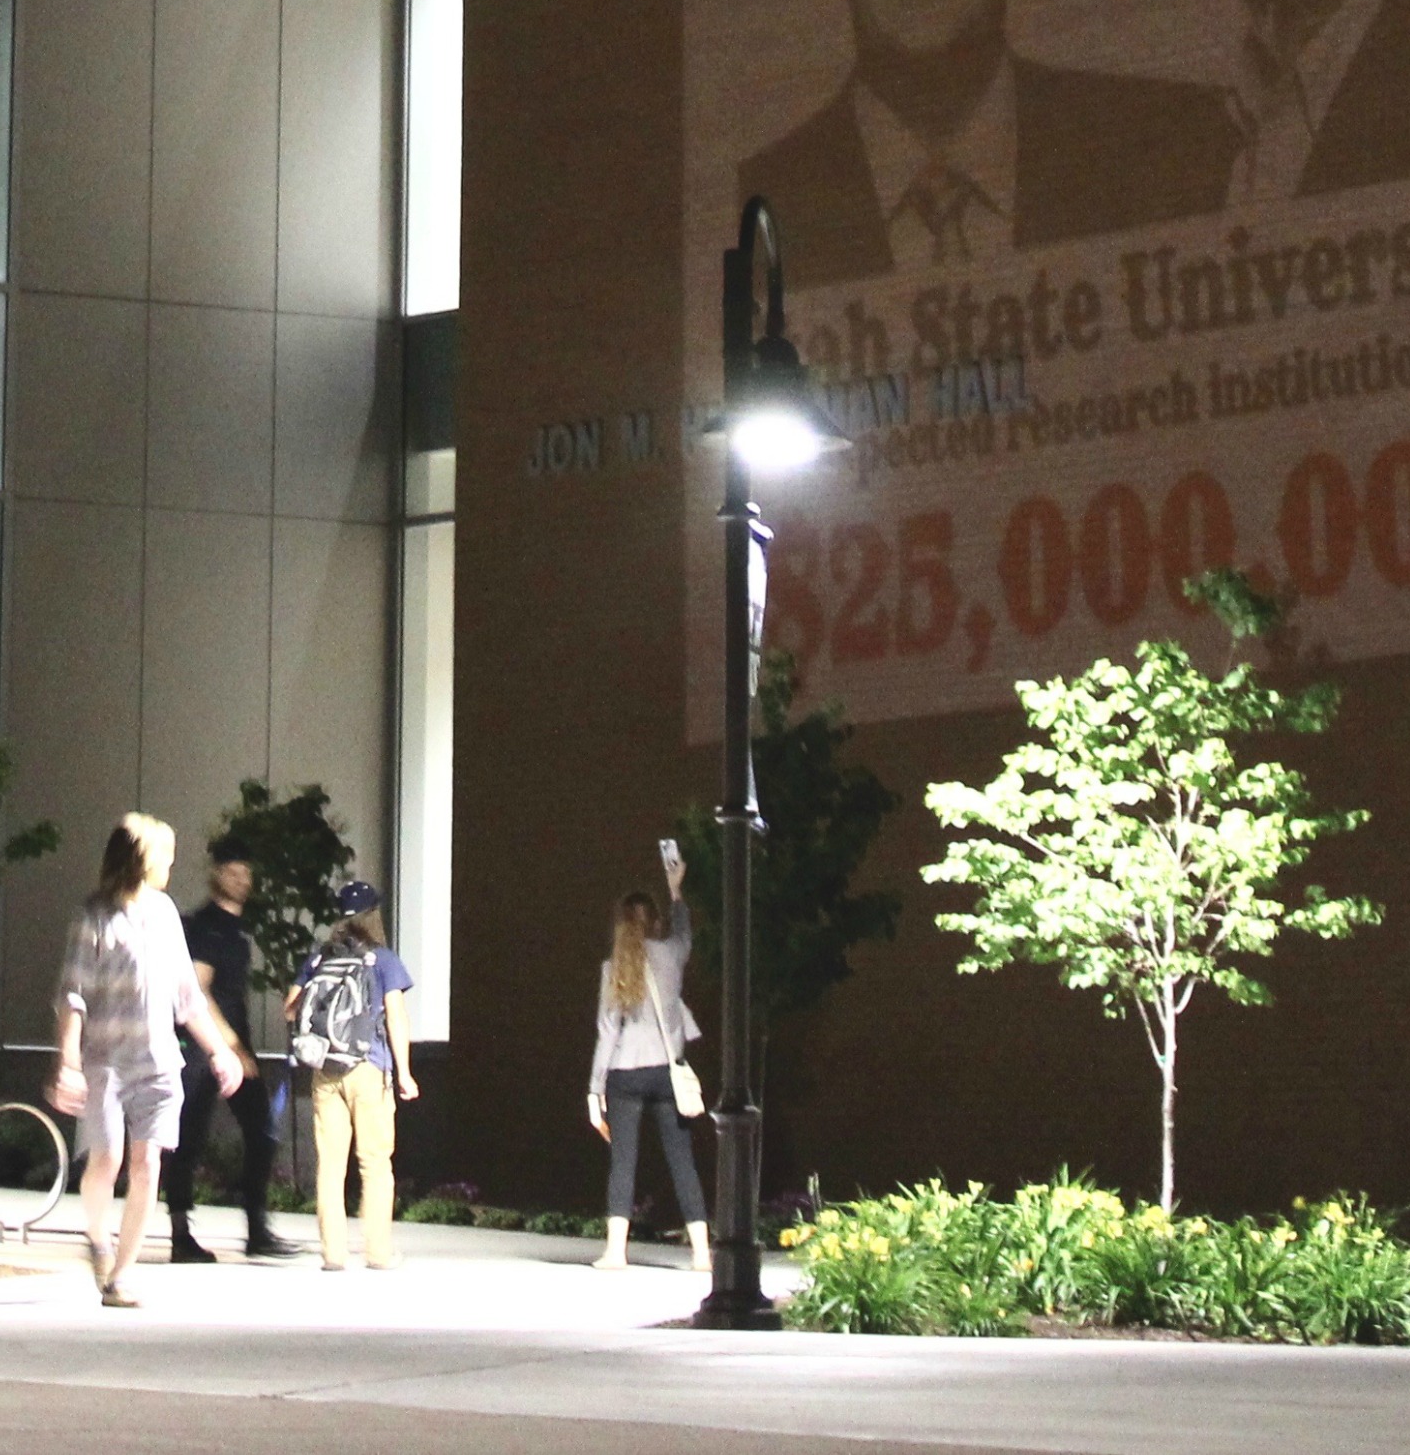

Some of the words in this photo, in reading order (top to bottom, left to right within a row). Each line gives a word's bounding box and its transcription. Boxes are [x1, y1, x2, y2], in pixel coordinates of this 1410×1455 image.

[910, 268, 1105, 379] State
[527, 416, 605, 476] JON
[680, 369, 910, 463] HMAN
[926, 355, 1033, 422] HALL
[1005, 372, 1202, 453] research
